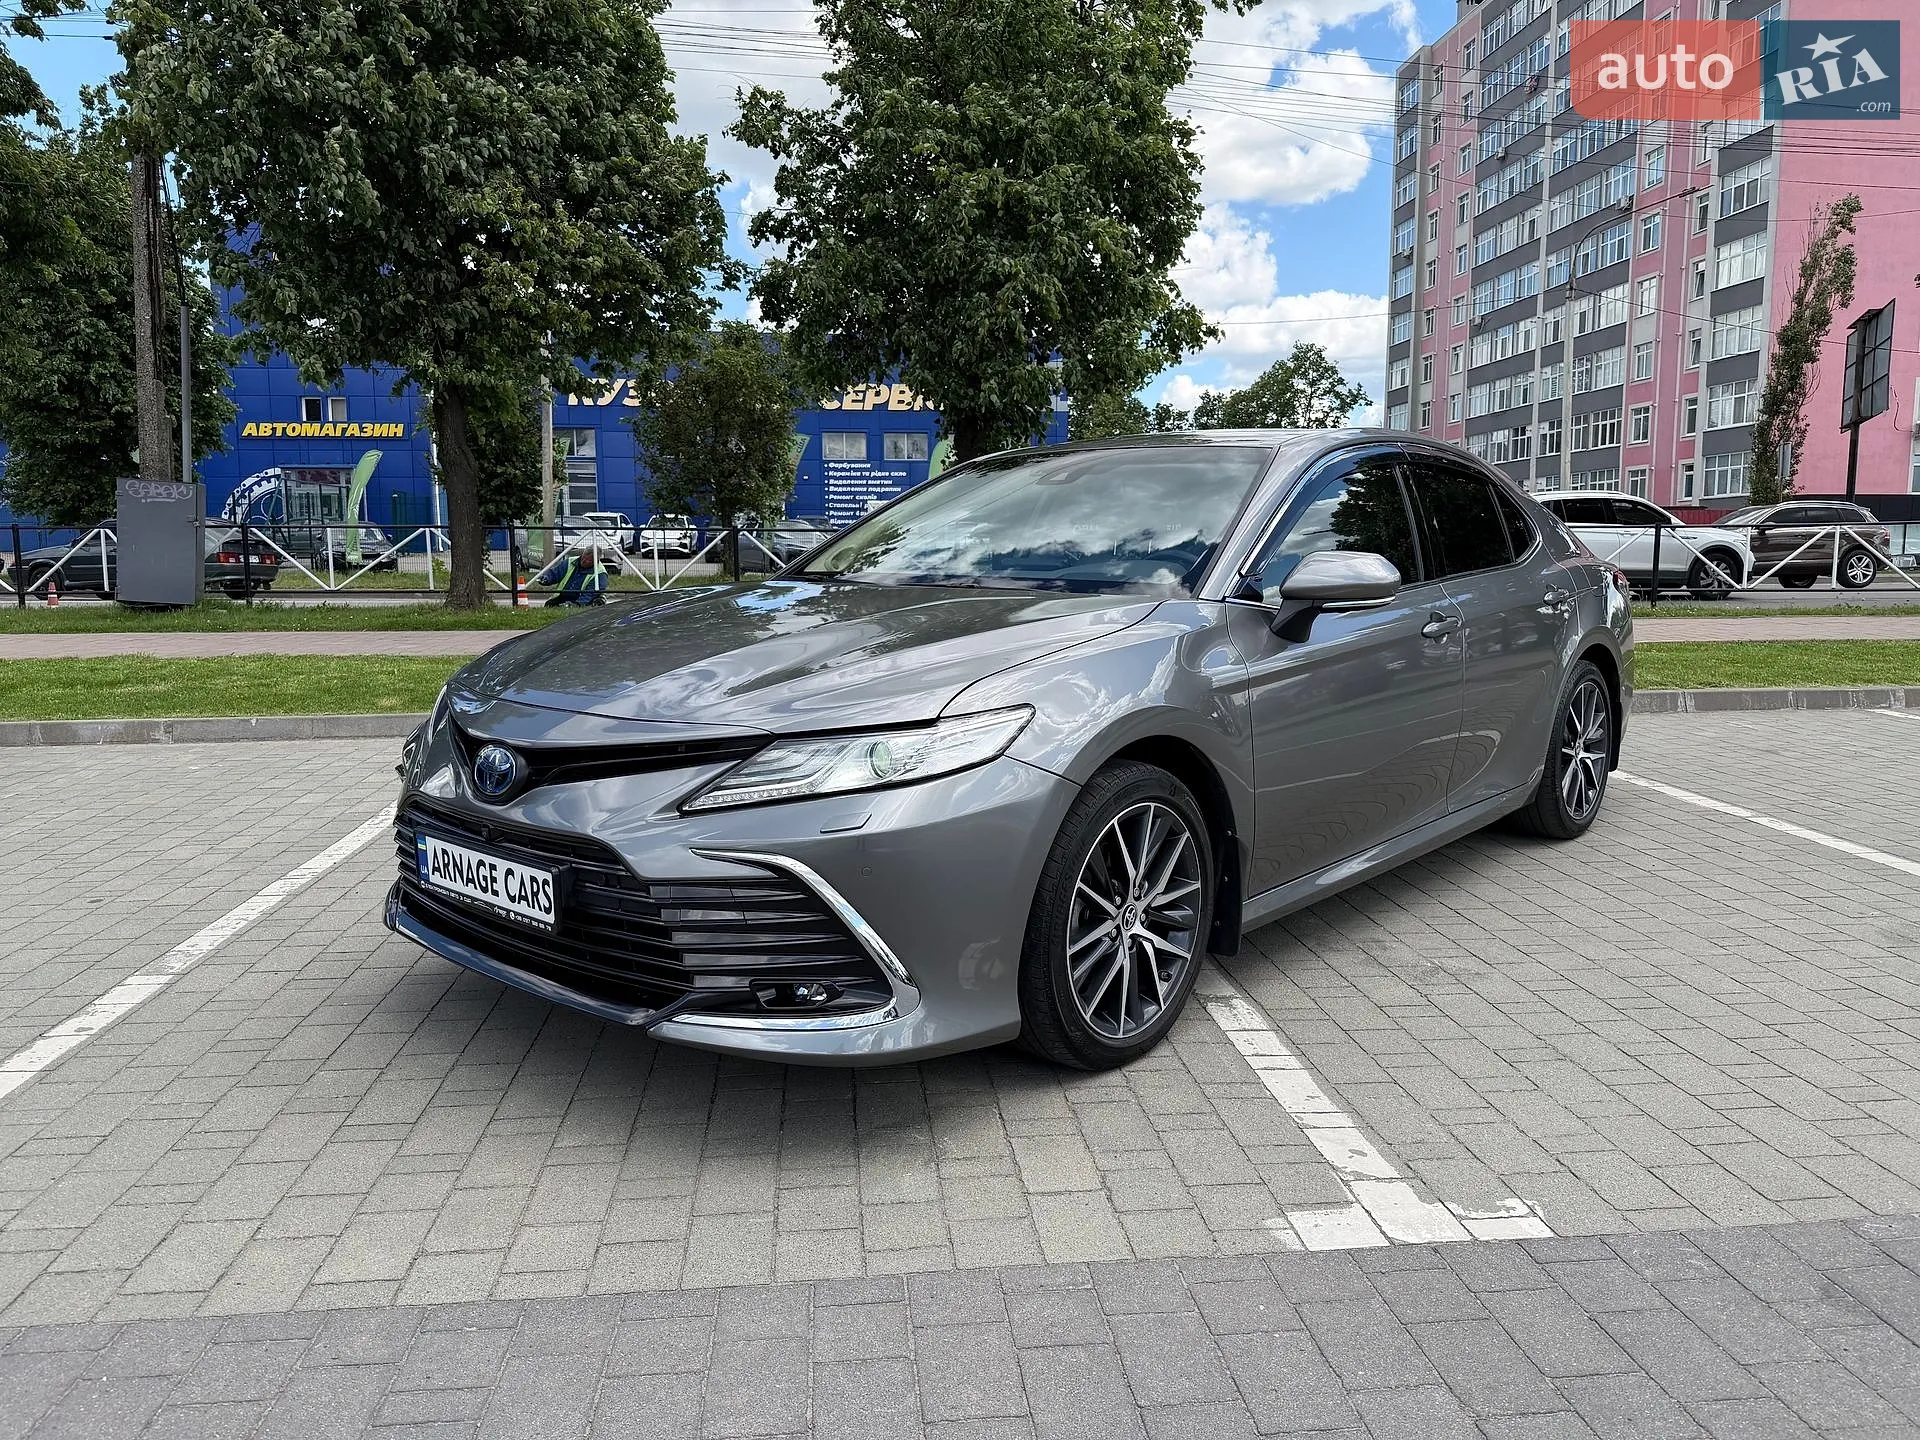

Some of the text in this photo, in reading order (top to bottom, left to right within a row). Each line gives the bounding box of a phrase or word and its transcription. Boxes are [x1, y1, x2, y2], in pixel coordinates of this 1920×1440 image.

[241, 422, 404, 437] АВТОМАГАЗИН
[829, 462, 871, 470] Фарбування
[871, 470, 889, 478] рідке
[420, 864, 429, 874] UA
[431, 844, 553, 916] ARNAGE CARS
